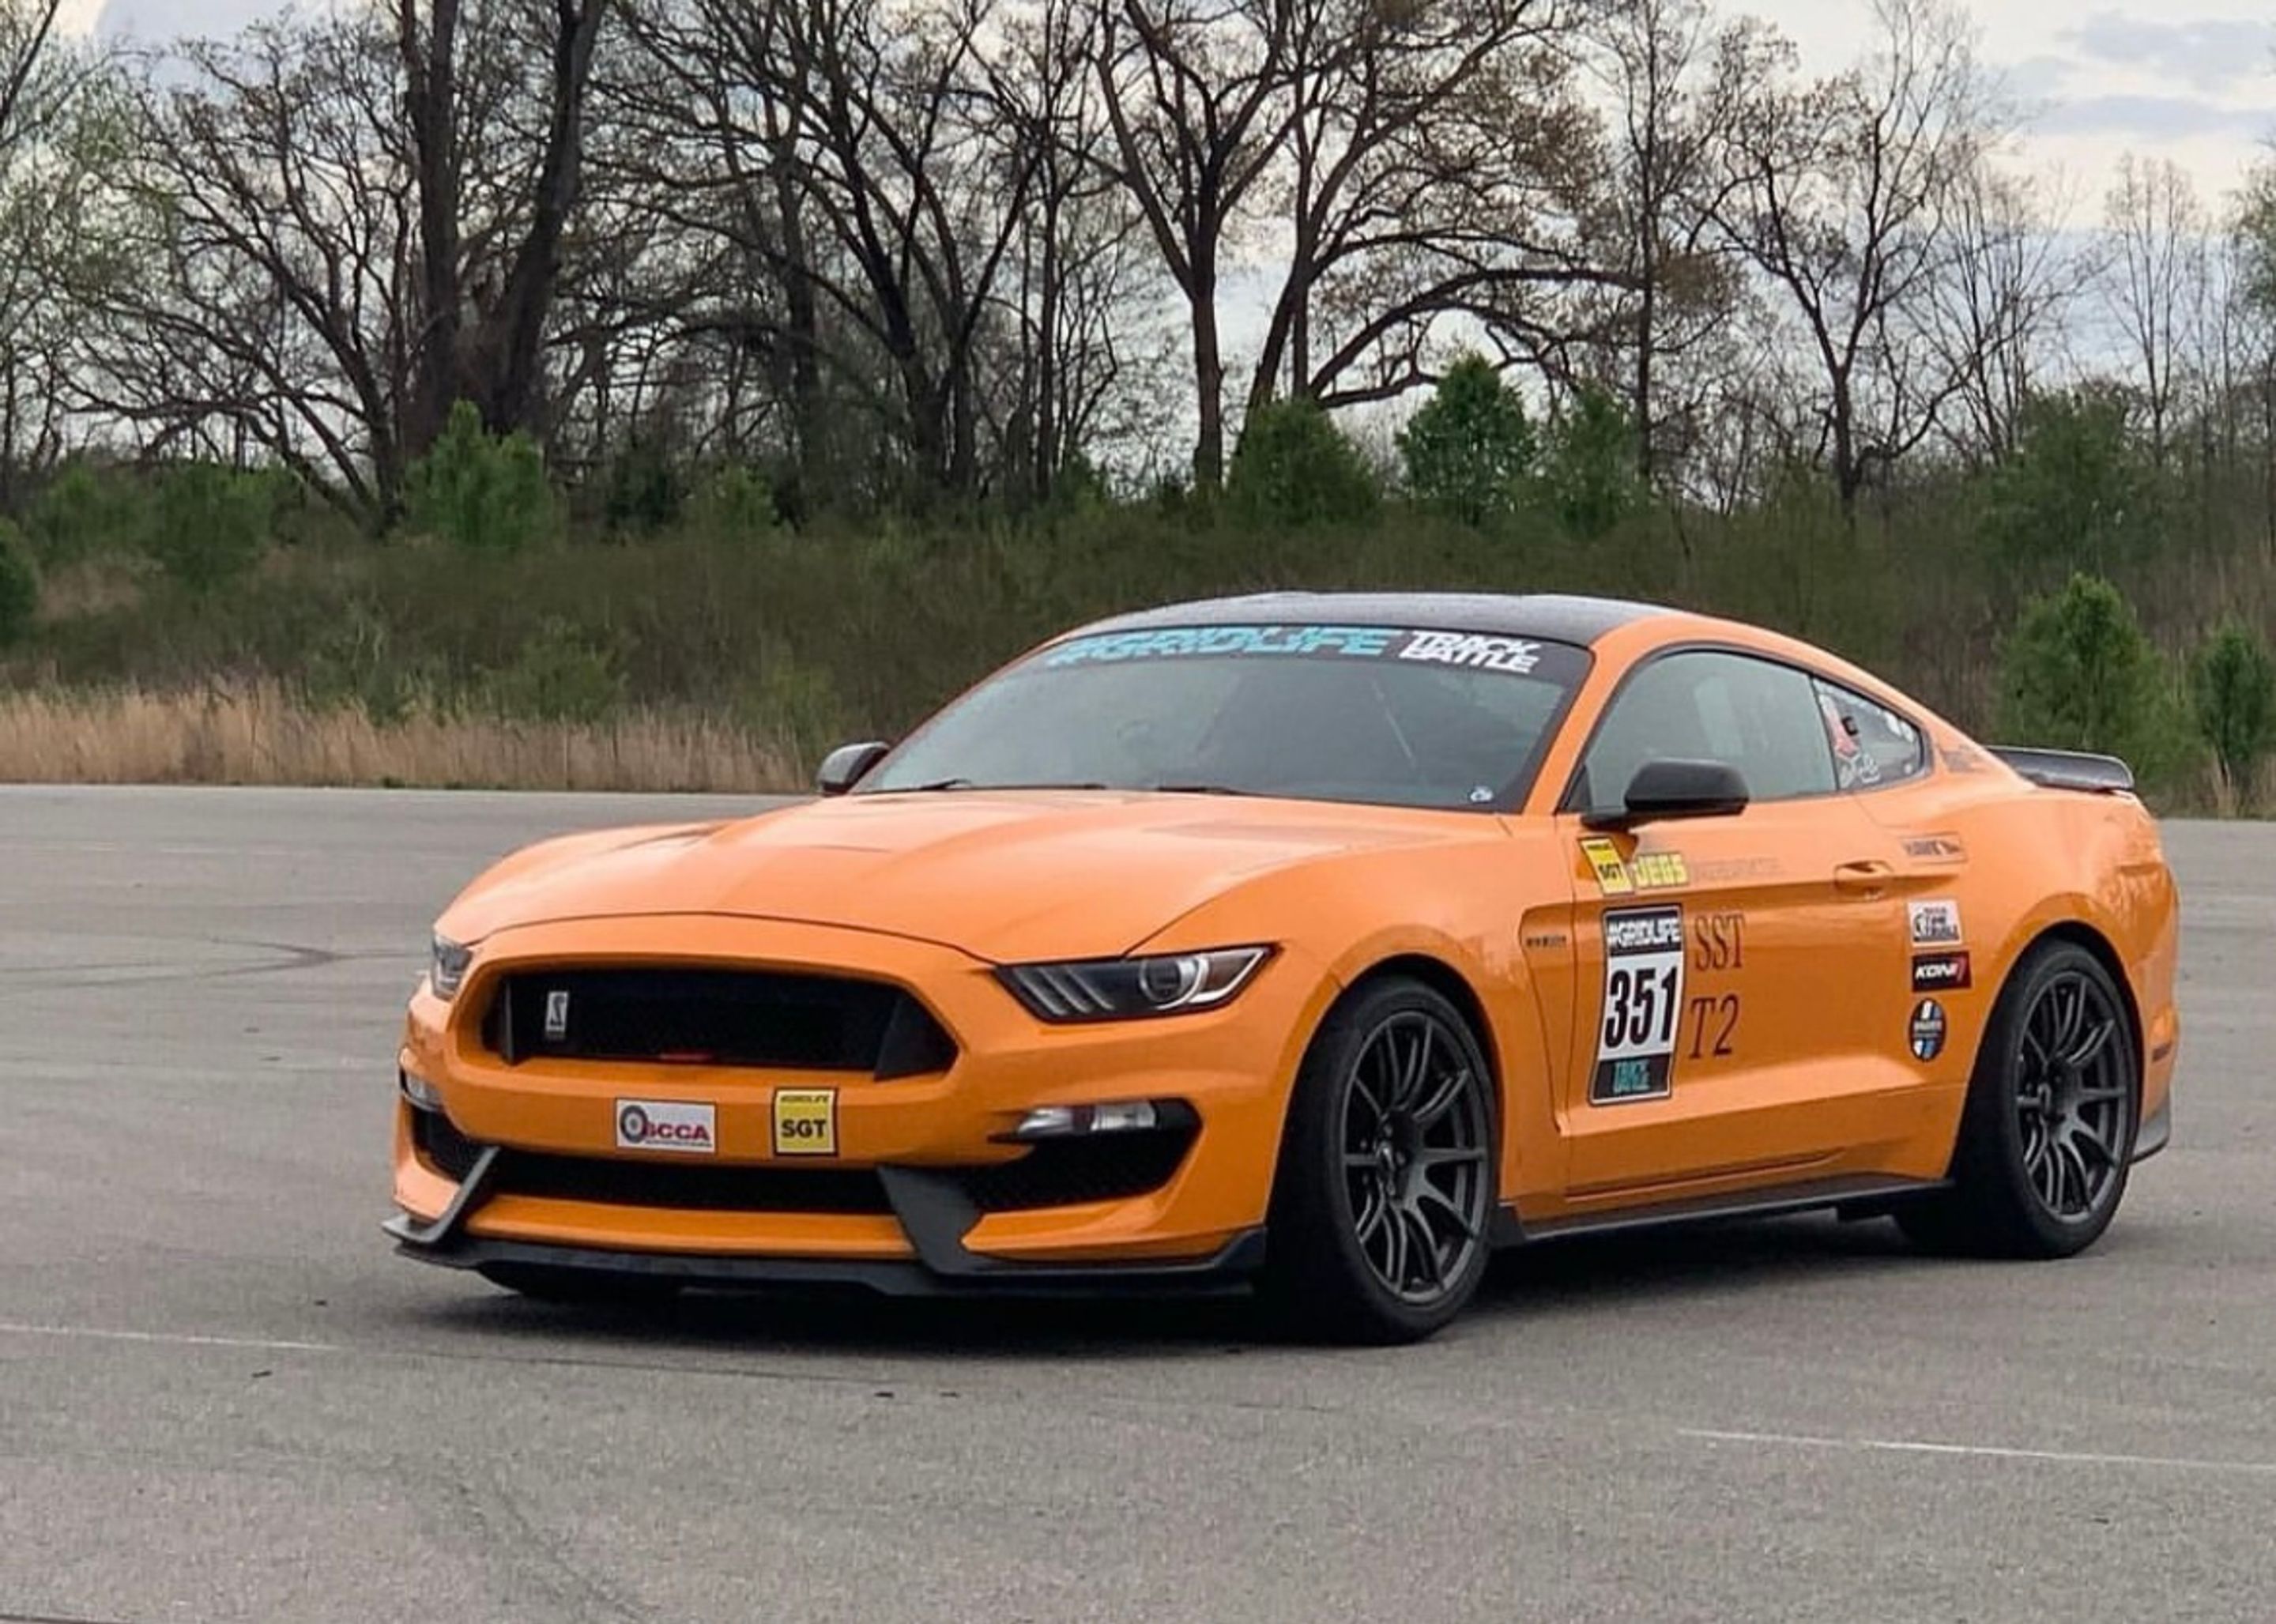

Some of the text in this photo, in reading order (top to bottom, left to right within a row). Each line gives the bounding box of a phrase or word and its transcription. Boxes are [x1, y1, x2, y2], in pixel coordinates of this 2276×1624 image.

[1408, 630, 1541, 654] TRACK
[1399, 646, 1539, 673] BATTLE
[1607, 917, 1681, 947] #GRIDLIFE
[1694, 913, 1746, 973] SST
[1915, 961, 1958, 981] KONI
[1604, 966, 1678, 1049] 351
[1689, 993, 1739, 1061] T2
[781, 1118, 827, 1139] SGT
